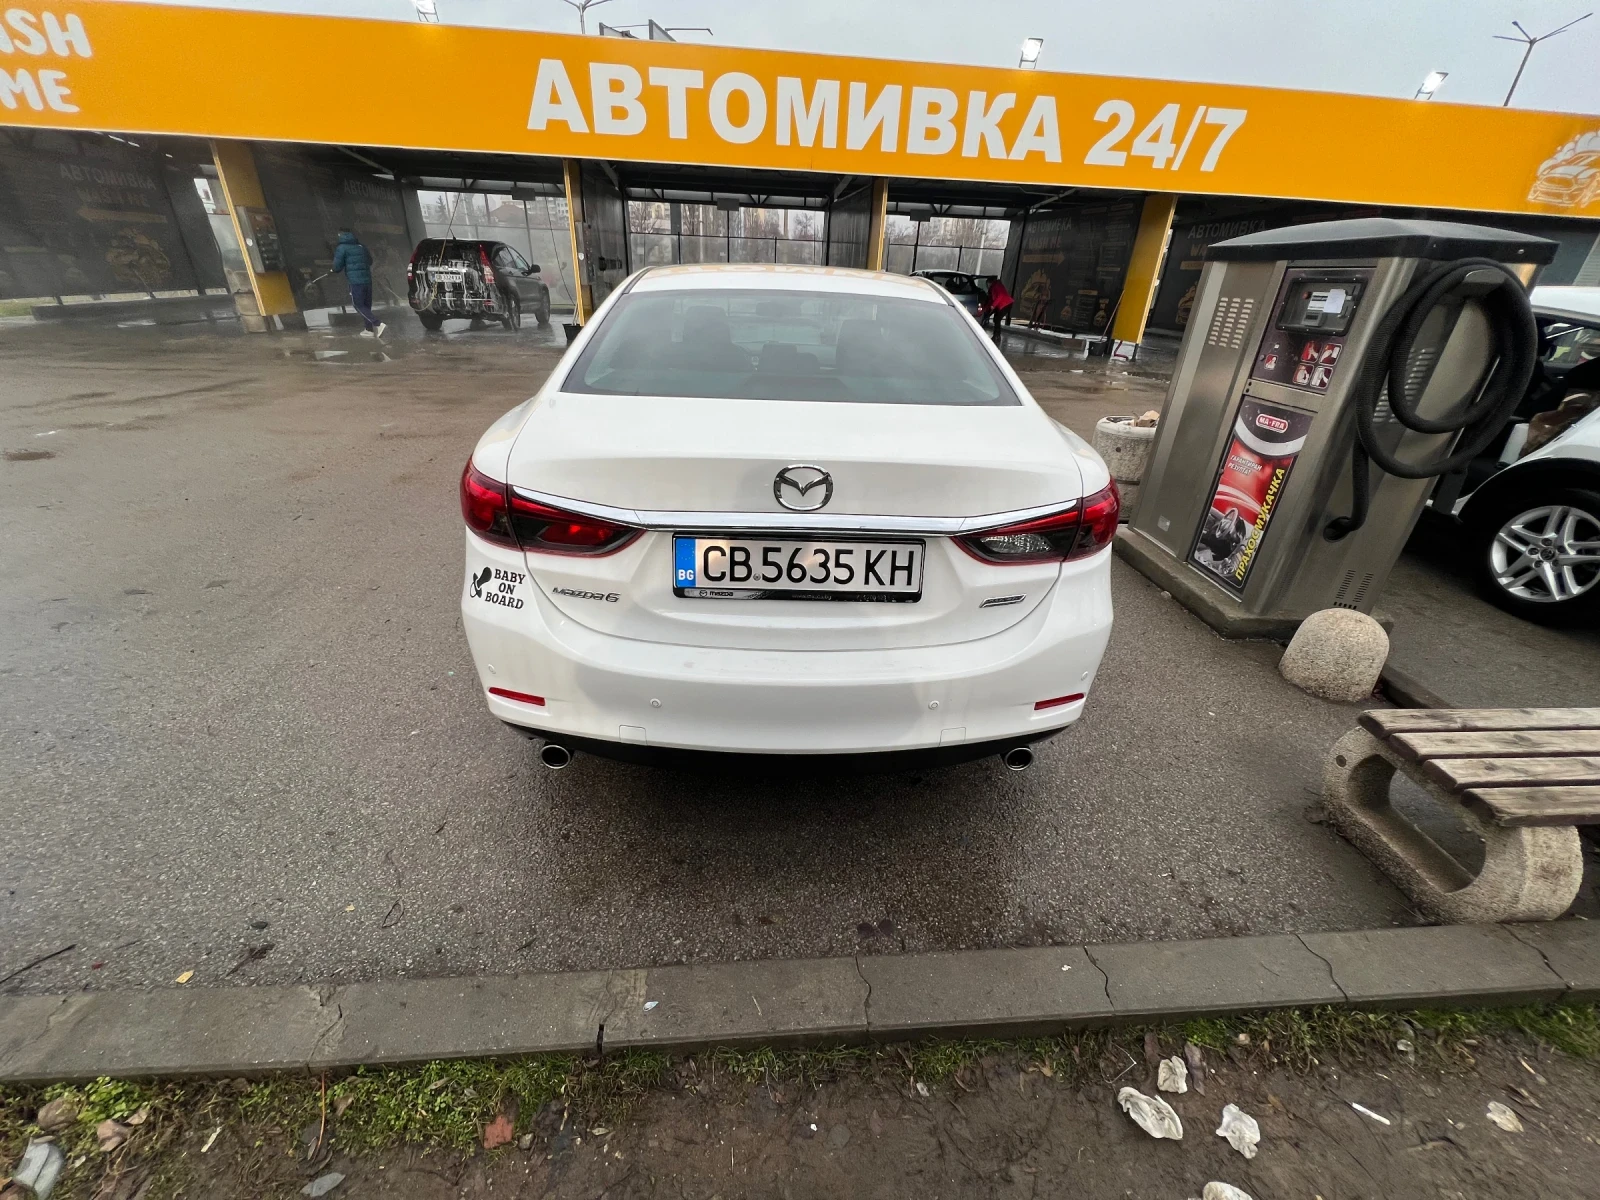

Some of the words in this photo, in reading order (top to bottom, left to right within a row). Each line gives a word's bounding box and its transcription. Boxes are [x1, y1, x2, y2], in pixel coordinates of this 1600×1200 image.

[0, 67, 81, 113] ME
[527, 58, 1062, 163] АВТОМИВКА
[1084, 99, 1247, 172] 24/7
[1235, 468, 1285, 581] ПРАХОСМУКАЧКА
[494, 568, 526, 585] BABY
[678, 569, 695, 581] BG
[498, 582, 516, 595] ON
[484, 591, 524, 610] BOARD
